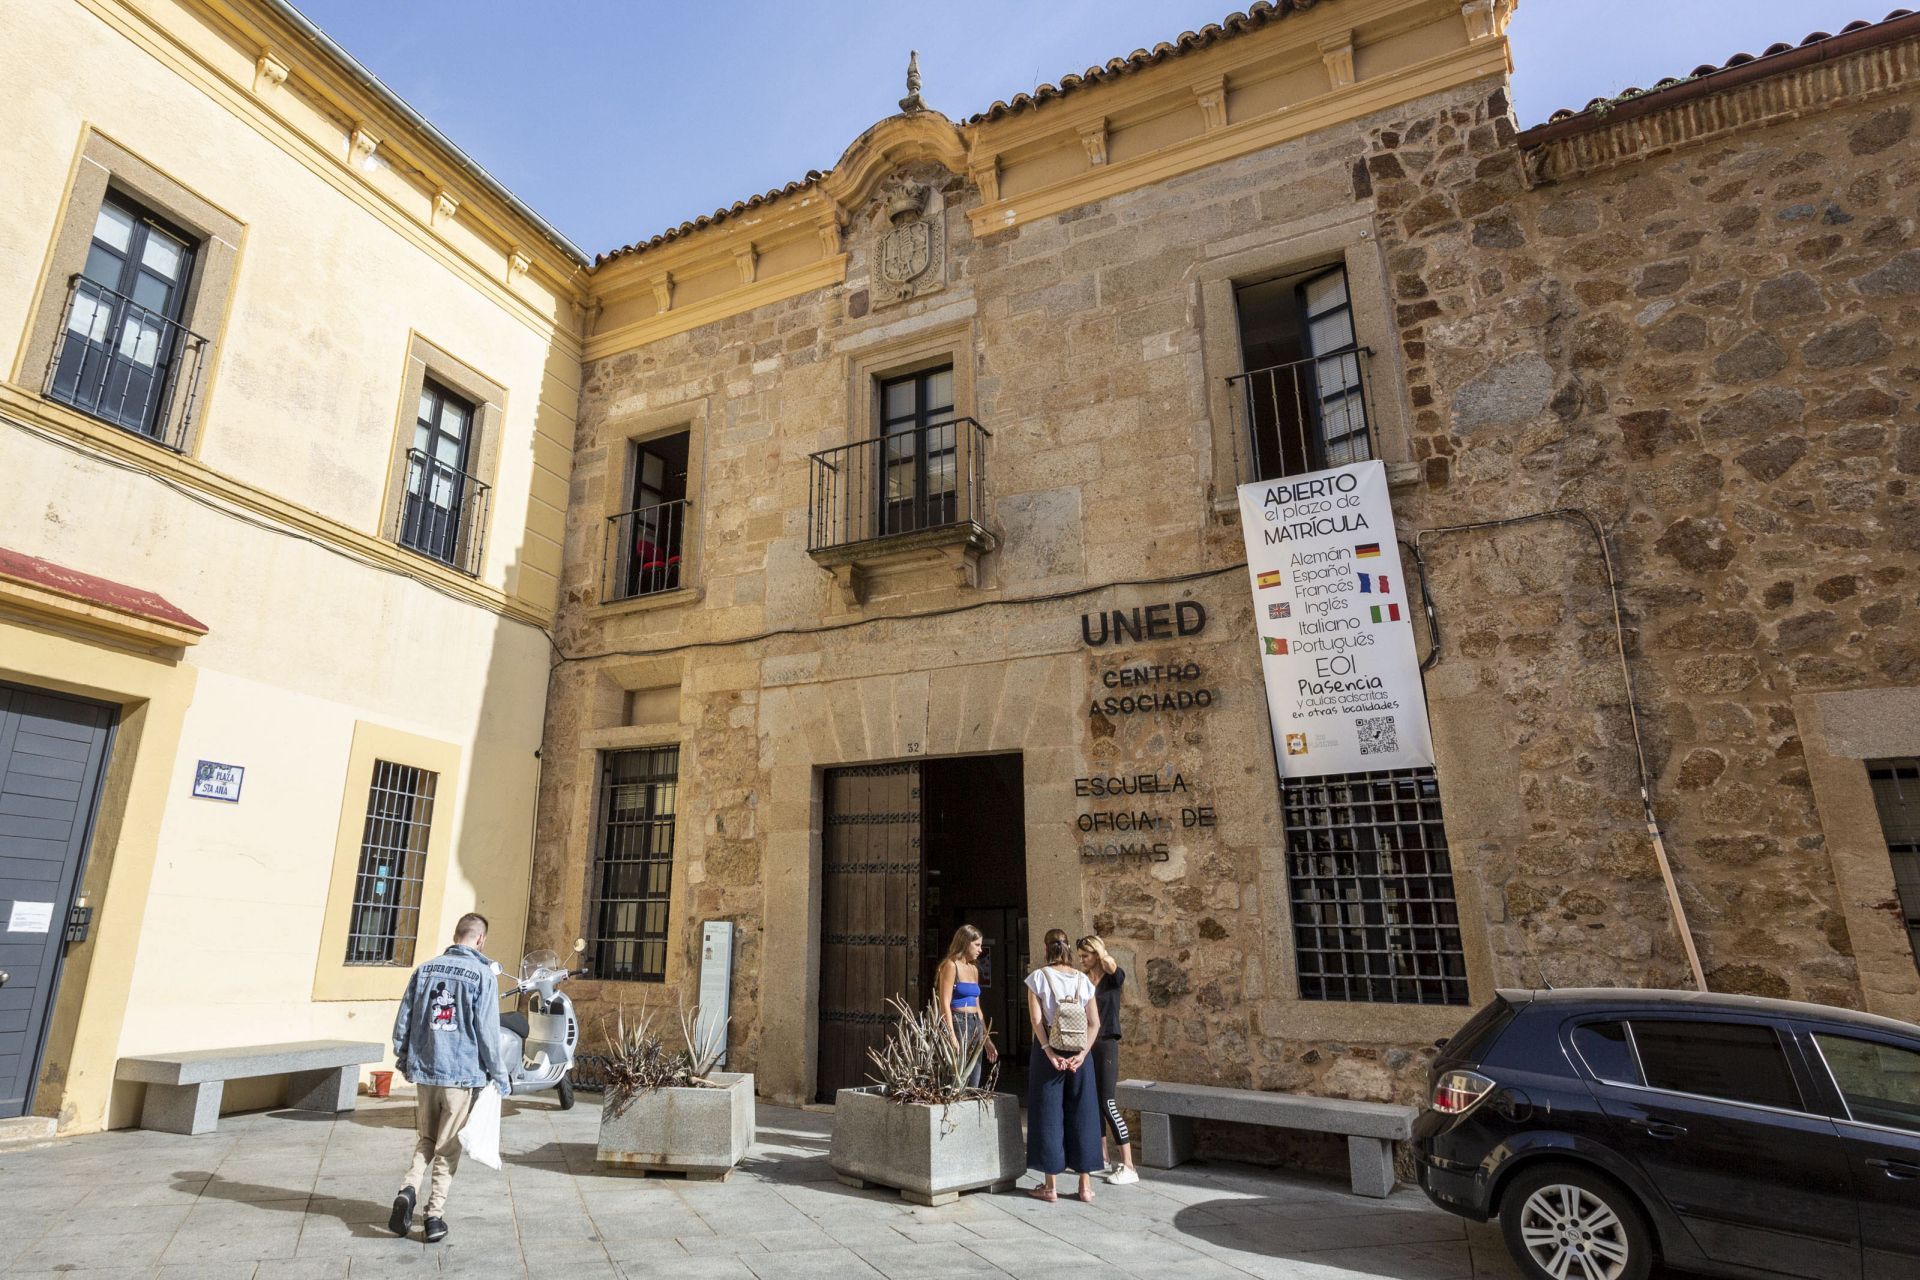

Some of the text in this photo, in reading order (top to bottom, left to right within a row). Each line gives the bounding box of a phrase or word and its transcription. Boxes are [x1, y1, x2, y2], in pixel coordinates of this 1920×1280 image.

[1264, 473, 1357, 507] ABIERTO
[1264, 494, 1360, 522] el plazo de
[1264, 513, 1369, 545] MATRÍCULA
[1290, 546, 1351, 567] Alemán
[1292, 563, 1351, 584] Español
[1294, 578, 1354, 598] Francés
[1304, 596, 1349, 616] Inglés
[1081, 600, 1207, 647] UNED
[1299, 617, 1361, 636] Italiano
[1292, 631, 1375, 655] Portugués
[1103, 662, 1200, 689] CENTRO
[1315, 654, 1357, 678] EOI
[1297, 675, 1383, 696] Plasencia
[1088, 688, 1212, 717] ASOCIADO
[1292, 700, 1400, 719] en otras localidades
[1296, 690, 1389, 708] y aulas adscritas
[216, 771, 234, 782] PLAZA
[1075, 773, 1187, 797] ESCUELA
[1181, 807, 1215, 828] DE
[422, 964, 446, 973] LEADER
[445, 965, 454, 974] OF
[453, 966, 466, 976] THE
